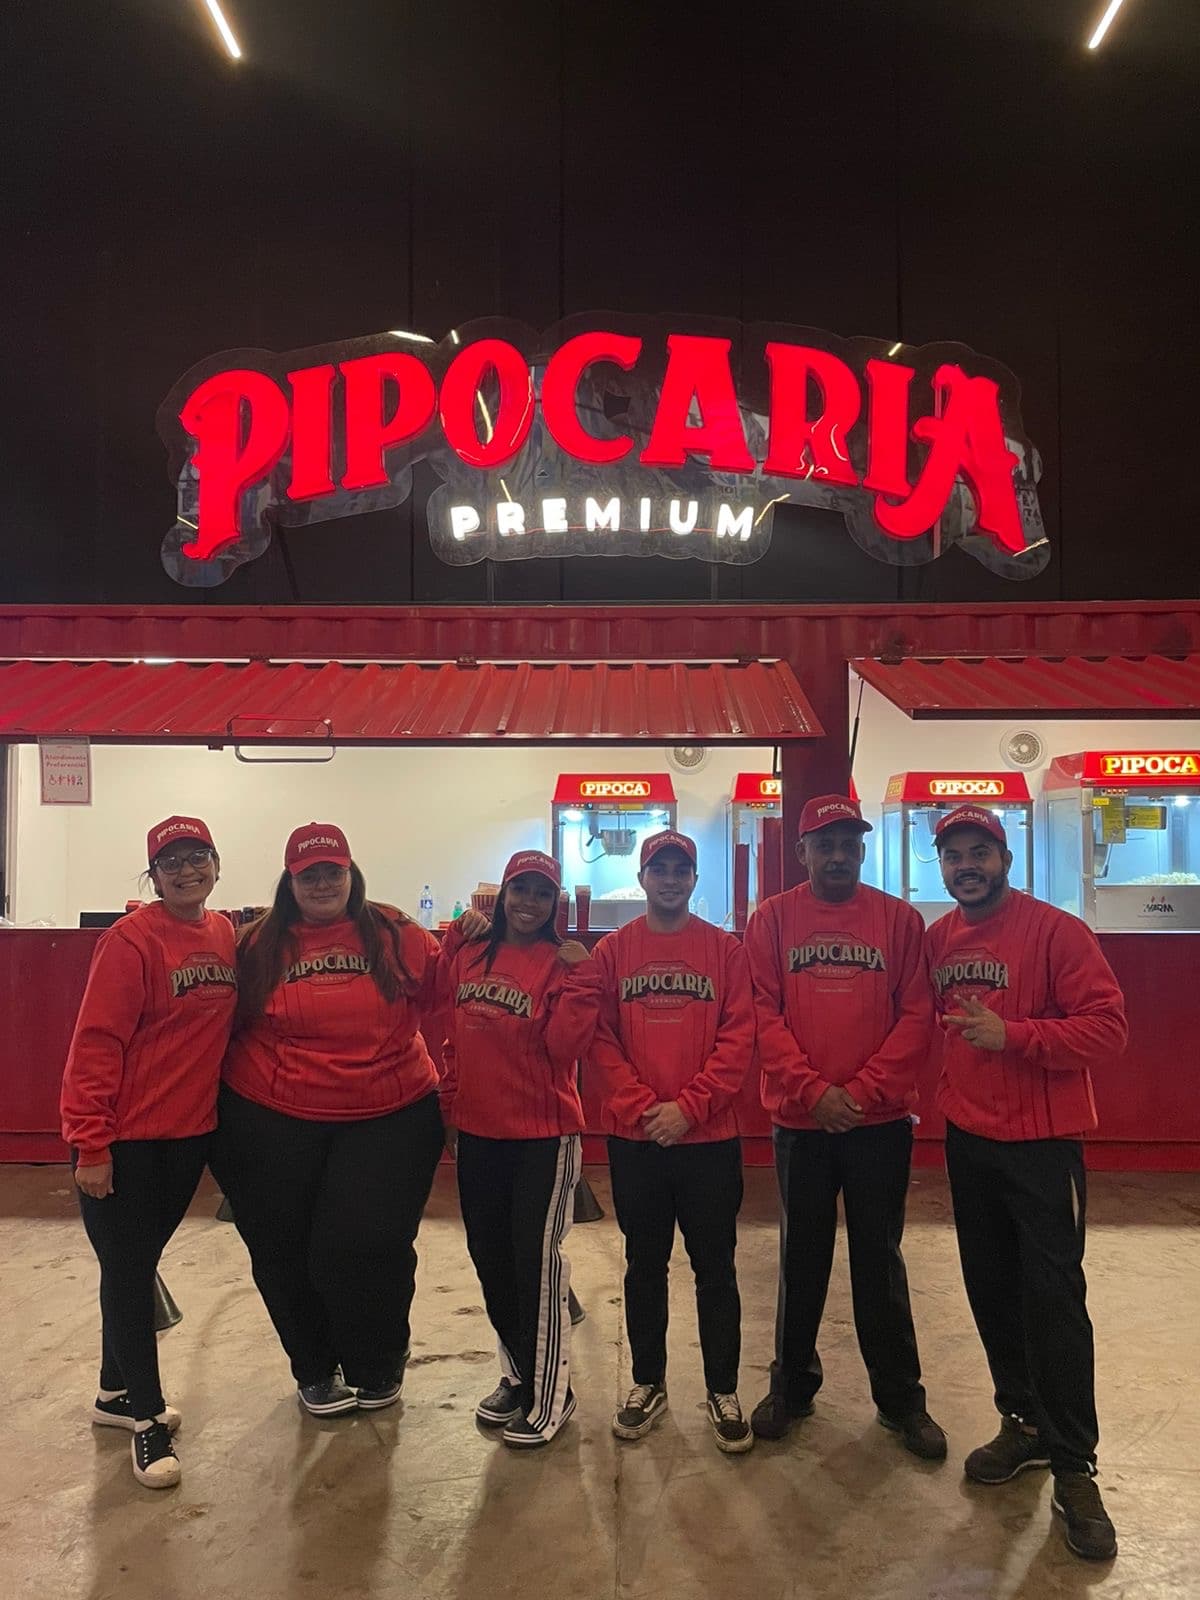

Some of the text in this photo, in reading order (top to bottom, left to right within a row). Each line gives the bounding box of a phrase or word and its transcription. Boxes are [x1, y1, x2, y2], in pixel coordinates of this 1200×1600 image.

[180, 331, 1026, 560] PIPOCARIA
[449, 496, 755, 541] PREMIUM
[1105, 756, 1199, 774] PIPOCA
[584, 782, 646, 796] PIPOCA
[934, 781, 999, 795] PIPOCA
[156, 823, 201, 843] PIPOCARIA
[297, 836, 340, 853] PIPOCARIA
[787, 944, 886, 972] PIPOCARIA
[170, 964, 238, 998] PIPOCARI
[621, 972, 716, 1002] PIPOCARIA
[934, 961, 1009, 996] PIPOCARIA
[455, 982, 533, 1019] PIPOCARIA
